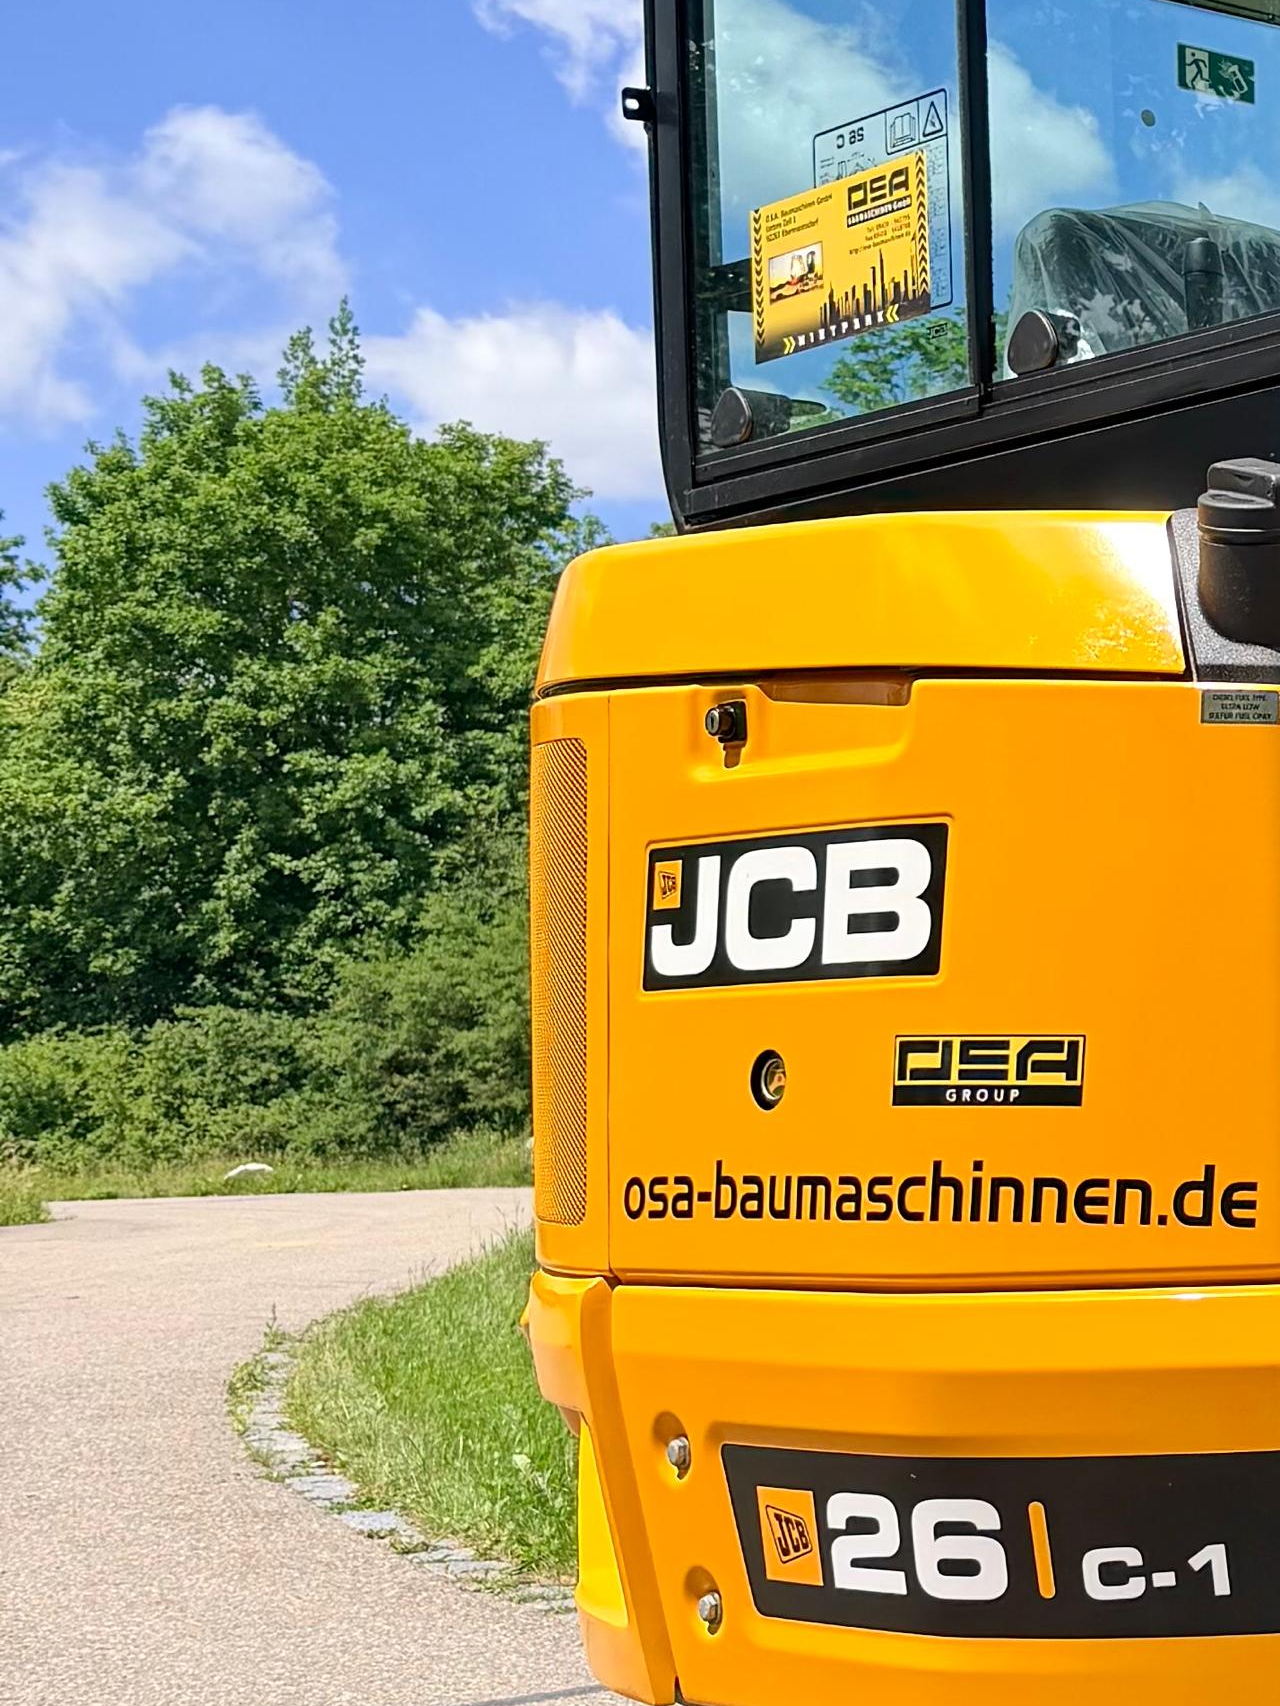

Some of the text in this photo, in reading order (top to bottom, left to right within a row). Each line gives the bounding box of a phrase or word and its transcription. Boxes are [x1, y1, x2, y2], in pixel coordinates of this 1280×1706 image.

[650, 838, 932, 977] JCB
[897, 1039, 1080, 1081] OSA
[945, 1088, 1020, 1102] GROUP
[623, 1160, 1259, 1229] osa-baumaschinnen.de
[773, 1512, 810, 1557] JCB
[826, 1492, 1232, 1601] 26 C-1
